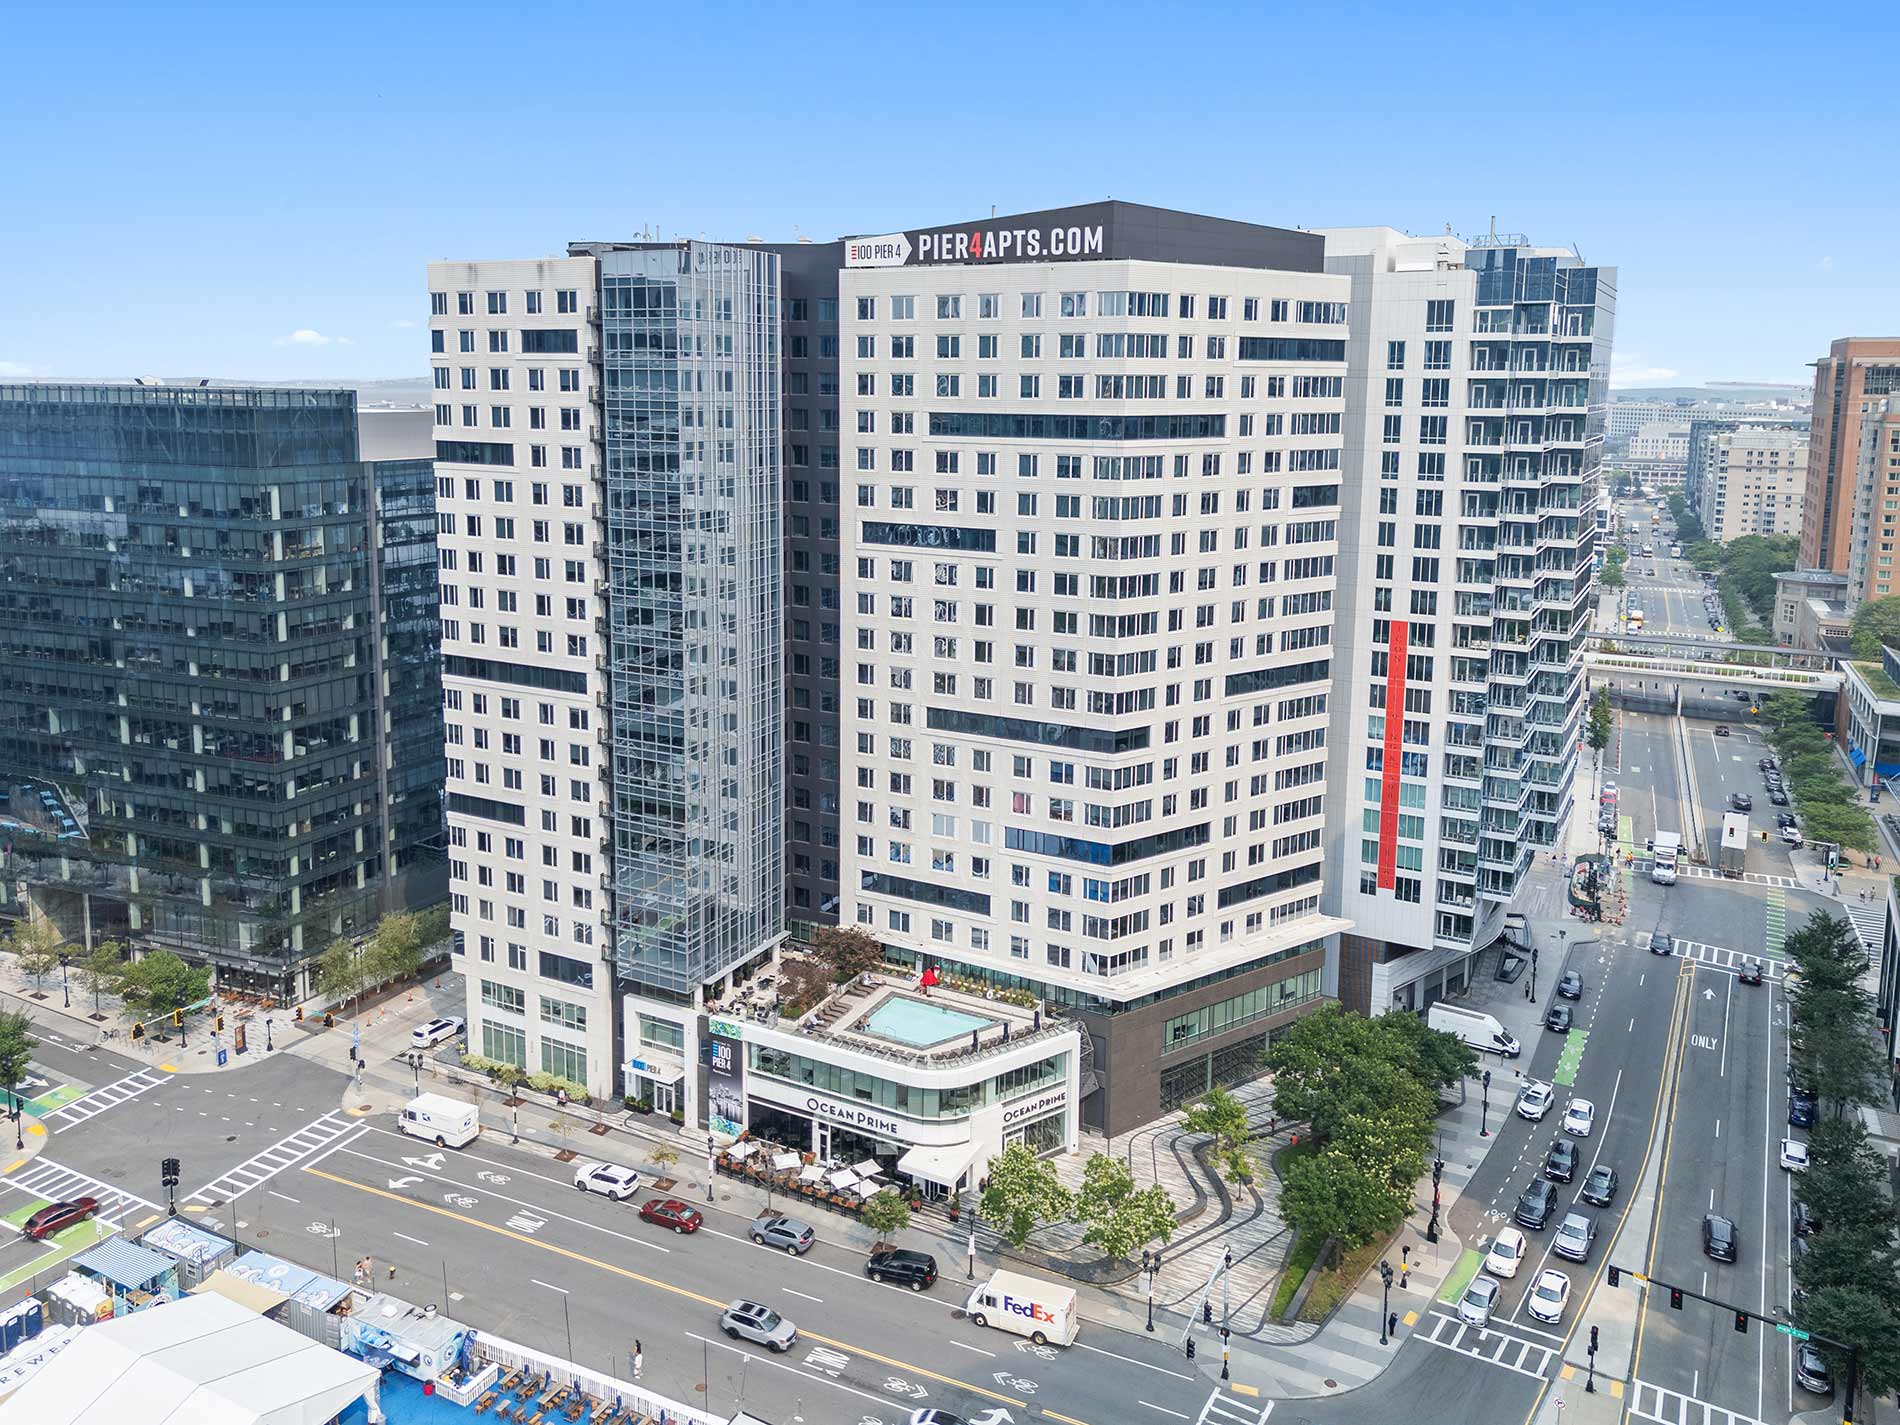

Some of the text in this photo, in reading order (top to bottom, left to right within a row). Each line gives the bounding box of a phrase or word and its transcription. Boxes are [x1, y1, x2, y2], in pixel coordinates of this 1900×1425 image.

[857, 243, 901, 260] 100 PIER 4
[918, 226, 1103, 261] PIER4APTS.COM
[717, 1045, 732, 1061] 100
[1691, 1034, 1718, 1051] ONLY
[712, 1056, 732, 1071] PIER 4
[806, 1098, 898, 1134] OCEAN PRIME
[1003, 1092, 1066, 1122] OCEAN PRIME
[505, 1209, 549, 1233] ONLY
[1004, 1295, 1055, 1325] FedEx
